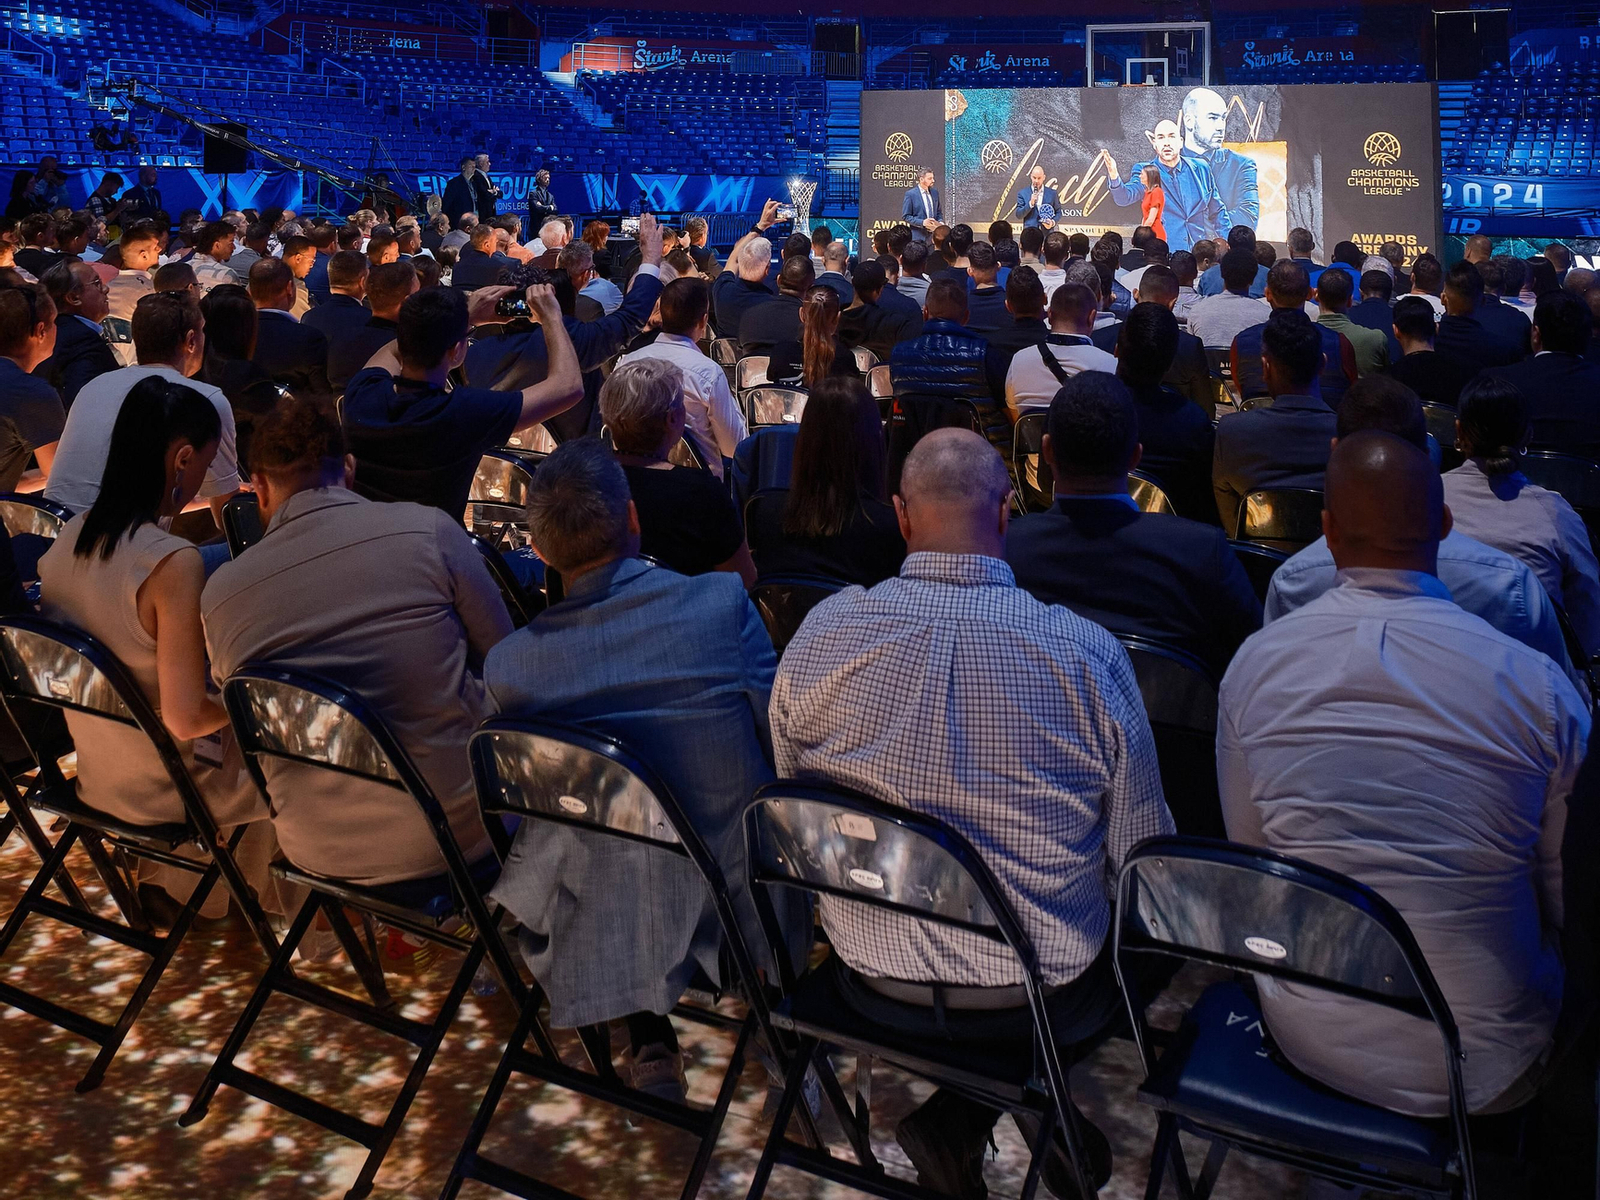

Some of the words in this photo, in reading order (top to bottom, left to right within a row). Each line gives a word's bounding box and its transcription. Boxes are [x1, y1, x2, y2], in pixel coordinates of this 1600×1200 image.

[1005, 54, 1050, 67] Arena
[872, 172, 918, 180] CHAMPION
[1351, 169, 1415, 178] BASKETBALL
[884, 180, 914, 188] LEAGUE
[1347, 177, 1420, 187] CHAMPIONS
[1364, 187, 1403, 195] LEAGUE
[1351, 233, 1417, 245] AWARDS
